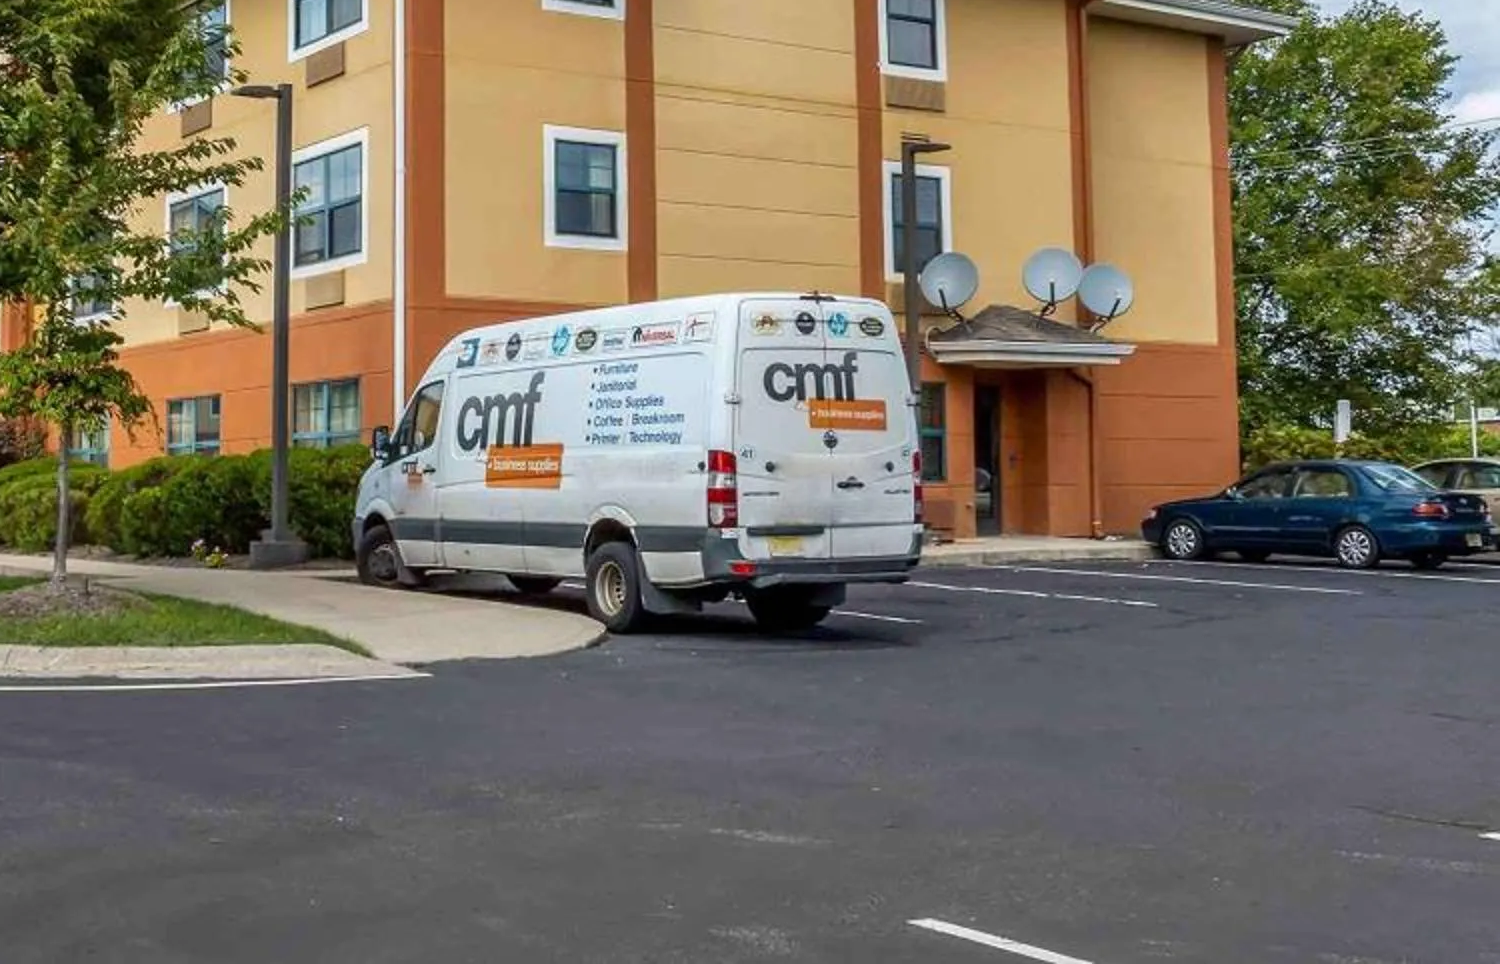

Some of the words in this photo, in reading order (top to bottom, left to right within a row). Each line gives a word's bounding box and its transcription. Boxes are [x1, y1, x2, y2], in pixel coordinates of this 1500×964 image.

[763, 351, 858, 402] cmf
[457, 371, 545, 451] cmf
[625, 395, 664, 410] Supplies
